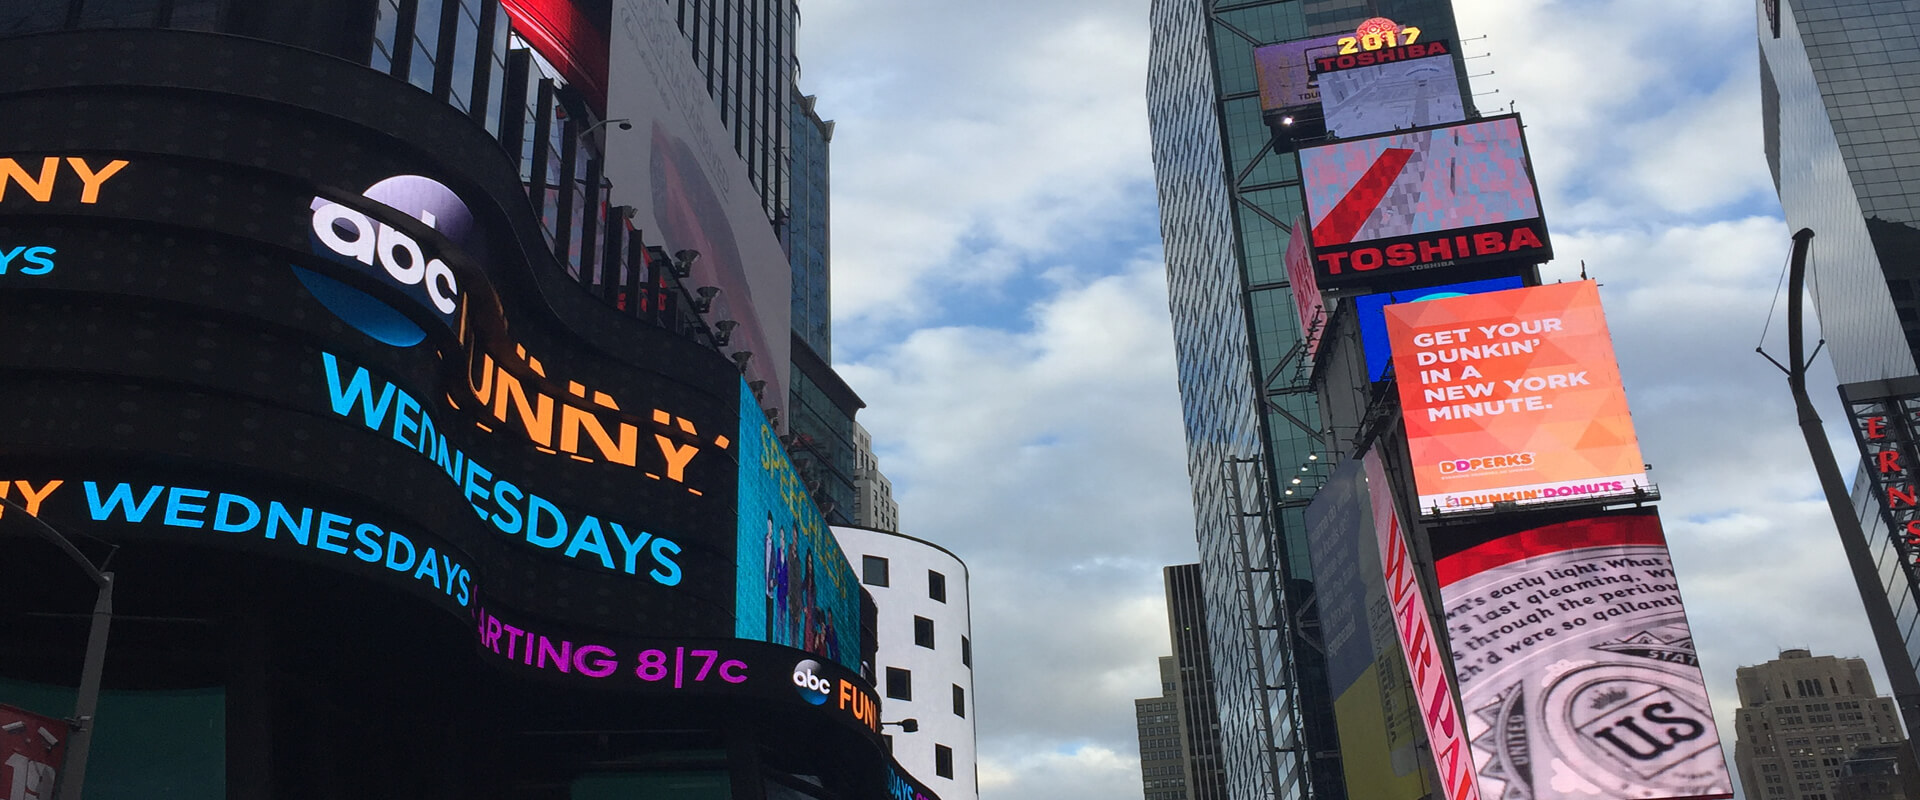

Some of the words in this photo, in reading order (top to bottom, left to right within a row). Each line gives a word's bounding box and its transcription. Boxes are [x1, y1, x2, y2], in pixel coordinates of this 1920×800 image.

[1318, 41, 1447, 71] TOSHIBA
[1338, 26, 1421, 55] 2017
[0, 156, 129, 204] NY
[310, 204, 458, 314] abc
[1318, 227, 1543, 275] TOSHIBA
[1410, 259, 1456, 272] TOSHIBA
[1413, 328, 1471, 348] GET
[1478, 317, 1563, 340] YOUR
[1420, 367, 1452, 385] IN
[1461, 365, 1482, 380] A
[1423, 382, 1495, 403] NEW
[1504, 371, 1590, 394] YORK
[1428, 396, 1553, 422] MINUTE.
[322, 352, 683, 587] WEDNESDAYS
[1440, 453, 1533, 474] DDPERKS
[1543, 481, 1623, 498] DONUTS
[1867, 416, 1920, 562] ERNS
[760, 423, 848, 601] SPEECHLESS
[1490, 577, 1546, 599] early
[1545, 562, 1607, 581] light,
[1604, 557, 1664, 569] What
[83, 480, 469, 606] WEDNESDAYS
[472, 585, 619, 678] ARTING
[793, 668, 831, 694] abc
[839, 678, 877, 733] FUN
[1465, 607, 1555, 651] through
[1558, 597, 1596, 611] the
[1598, 582, 1680, 604] perilou
[1472, 600, 1521, 624] last
[1504, 626, 1558, 654] were
[1561, 616, 1587, 630] so
[1507, 714, 1525, 766] UNITED
[1595, 702, 1705, 761] US
